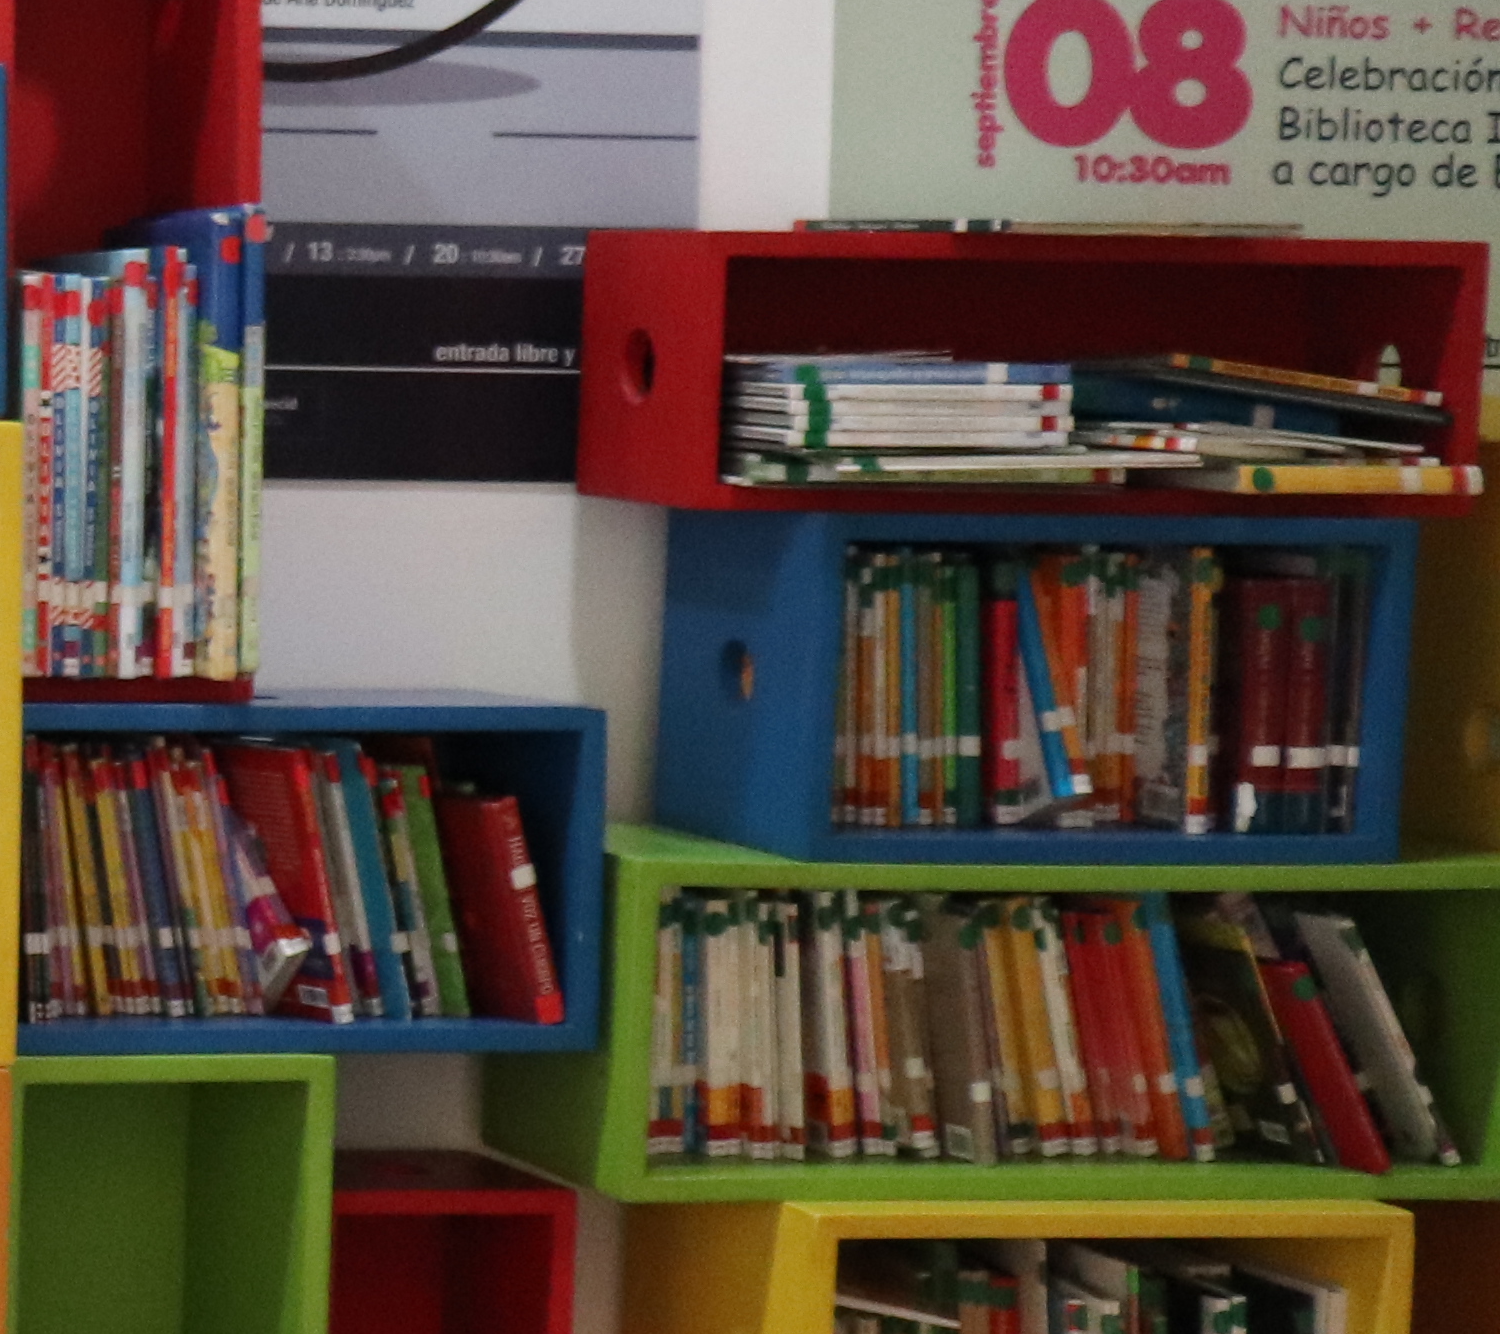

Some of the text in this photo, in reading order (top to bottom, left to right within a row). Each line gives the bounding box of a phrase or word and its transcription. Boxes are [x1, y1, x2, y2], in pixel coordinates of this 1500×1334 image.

[1277, 3, 1391, 41] Niños
[1412, 17, 1434, 35] +
[1279, 106, 1473, 144] Biblioteca
[1073, 154, 1233, 186] 10:30am
[1272, 151, 1479, 197] a cargo de
[306, 241, 335, 264] 13
[431, 242, 461, 266] 20
[432, 342, 577, 369] entrada libre y
